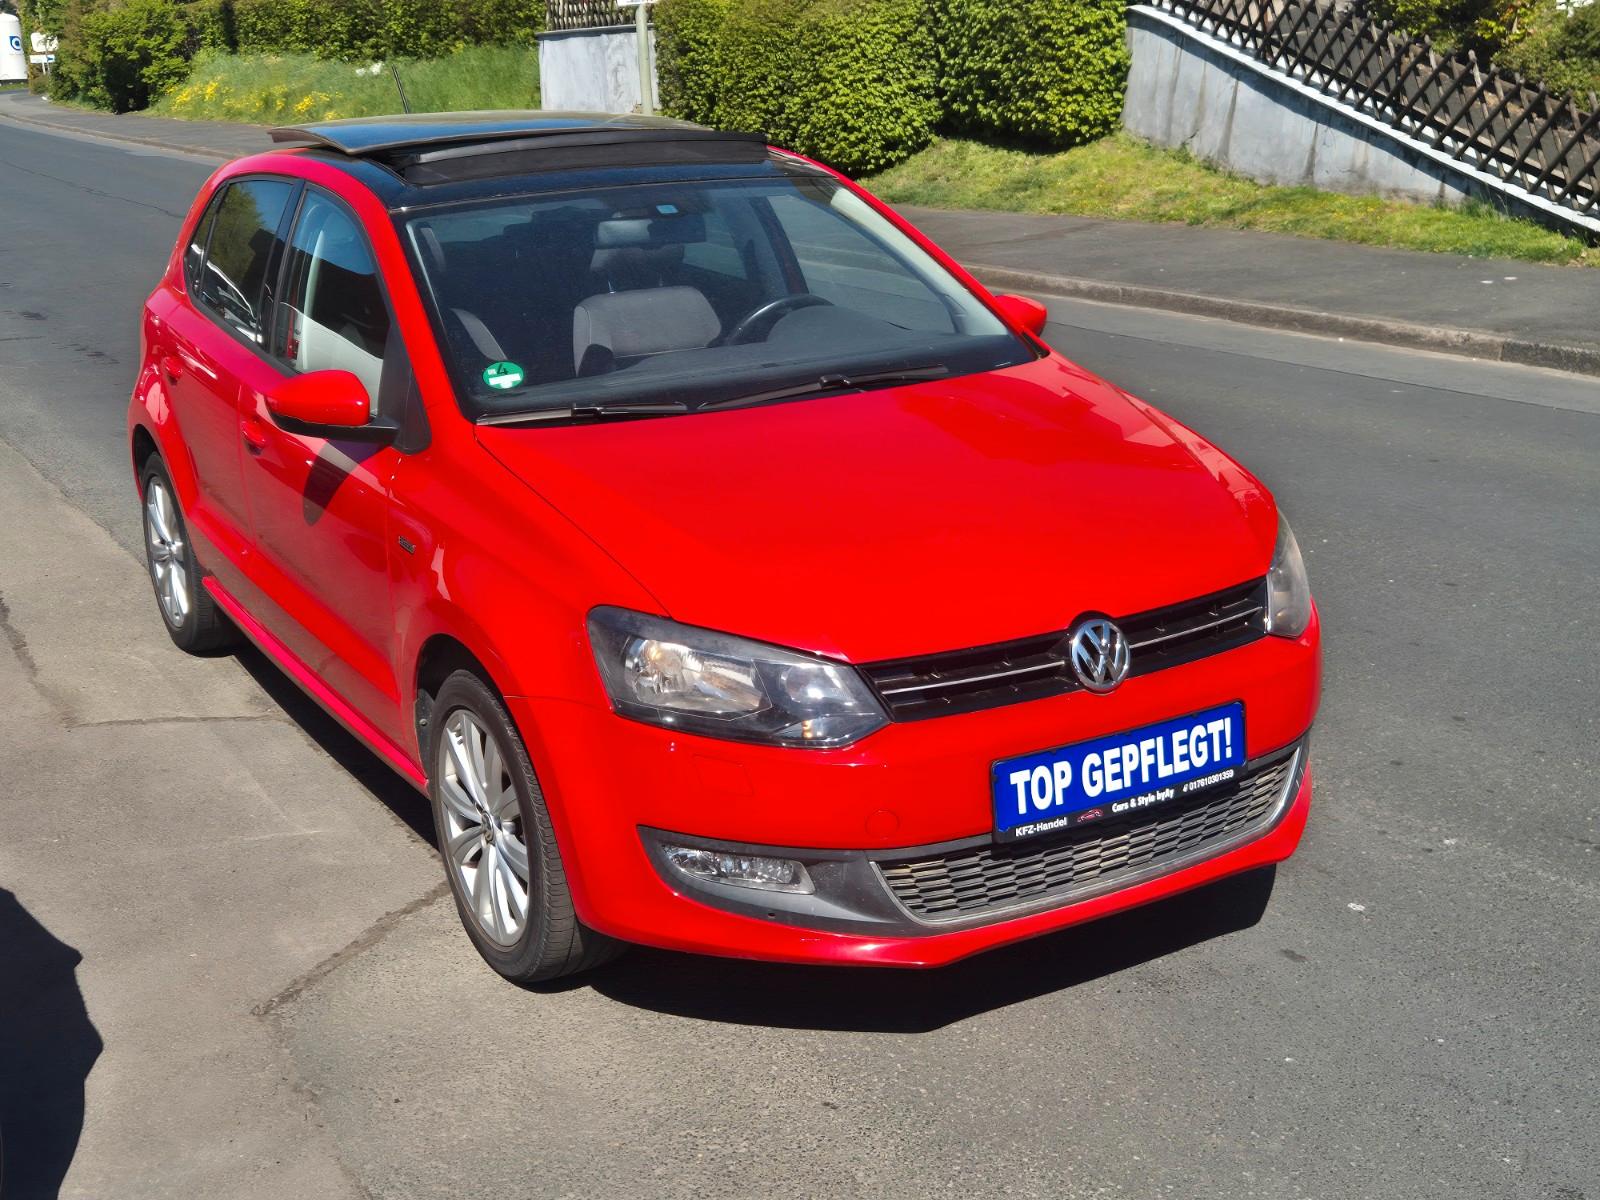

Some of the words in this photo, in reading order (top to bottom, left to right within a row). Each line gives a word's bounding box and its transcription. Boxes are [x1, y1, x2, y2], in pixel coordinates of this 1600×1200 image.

[1071, 619, 1130, 689] VW
[1009, 760, 1072, 815] TOP
[1081, 717, 1233, 798] GEPFLEGT!
[1015, 817, 1068, 837] KFZ-Handel
[1111, 801, 1129, 813] Cars
[1130, 798, 1136, 808] &
[1137, 793, 1156, 806] Style
